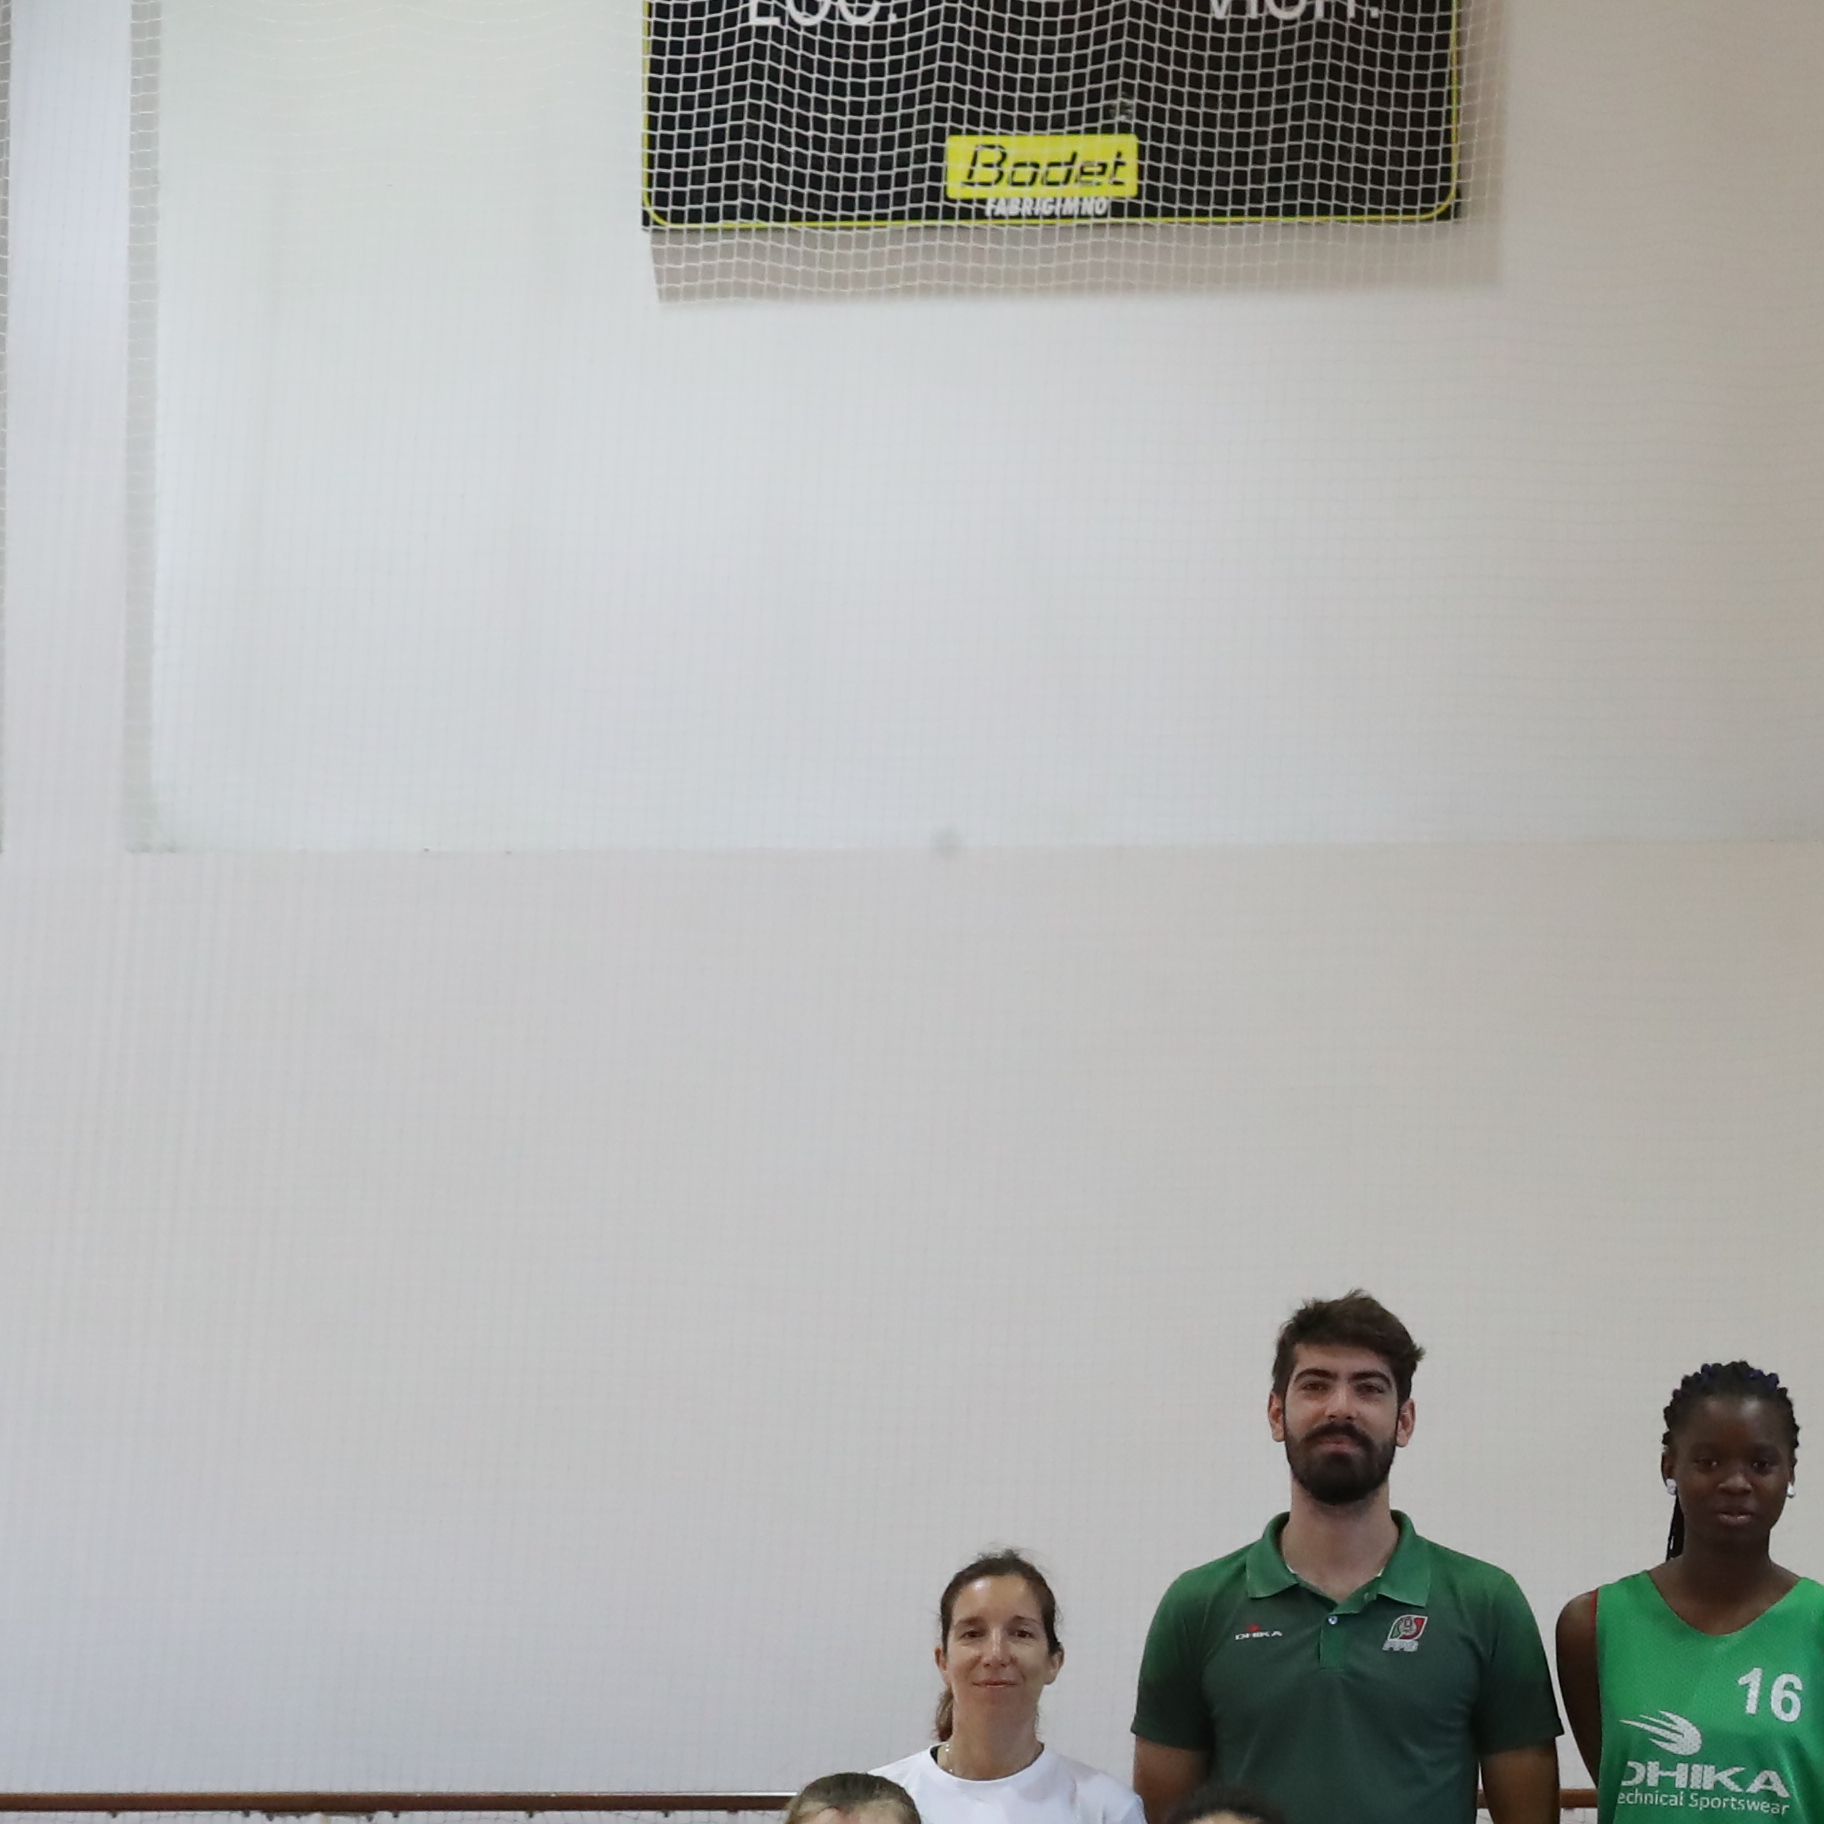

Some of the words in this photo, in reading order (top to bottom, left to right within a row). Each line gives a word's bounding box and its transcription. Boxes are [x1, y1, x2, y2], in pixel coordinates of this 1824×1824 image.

[959, 144, 1128, 187] Bodet
[1737, 1667, 1804, 1722] 16
[1620, 1760, 1790, 1798] DHIKA
[1617, 1788, 1685, 1807] echnical
[1688, 1793, 1790, 1815] Sportswear
